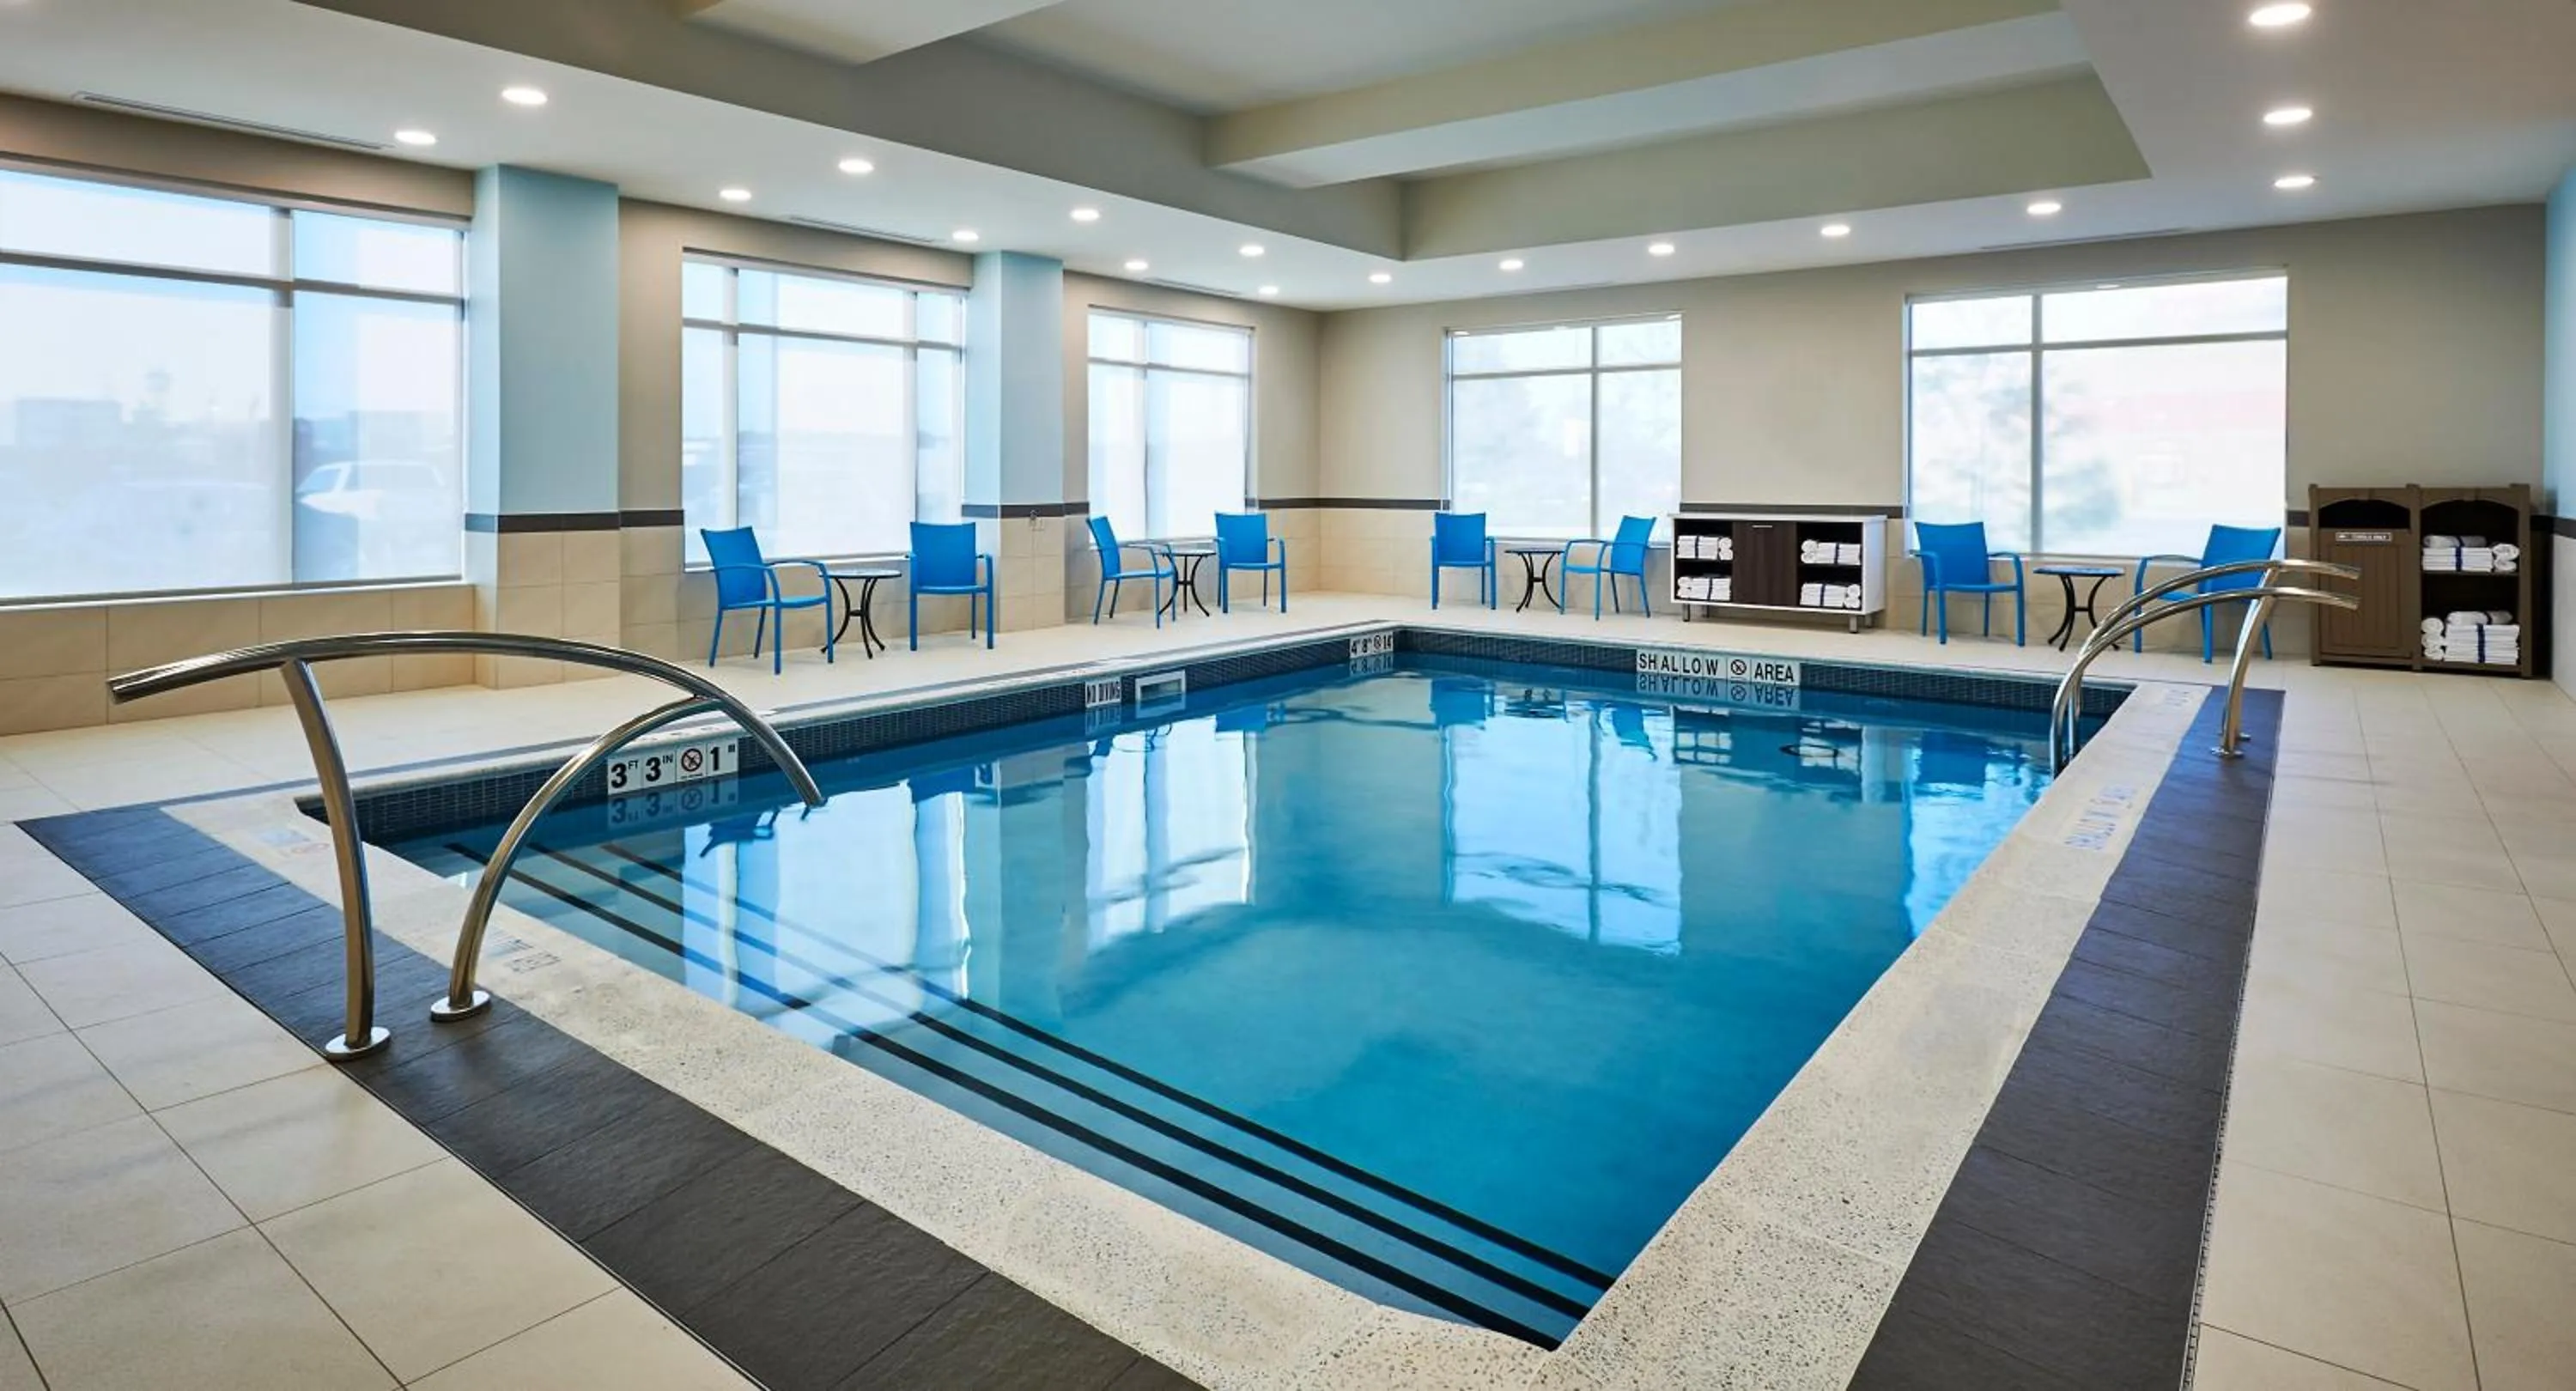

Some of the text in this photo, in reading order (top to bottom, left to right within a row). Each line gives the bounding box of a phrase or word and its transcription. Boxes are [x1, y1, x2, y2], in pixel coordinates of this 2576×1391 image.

[1638, 653, 1795, 683] SHALLOW AREA
[611, 762, 628, 788] 3
[628, 760, 639, 770] FT
[645, 756, 661, 782] 3
[662, 754, 673, 764] IN
[709, 746, 720, 771] 1
